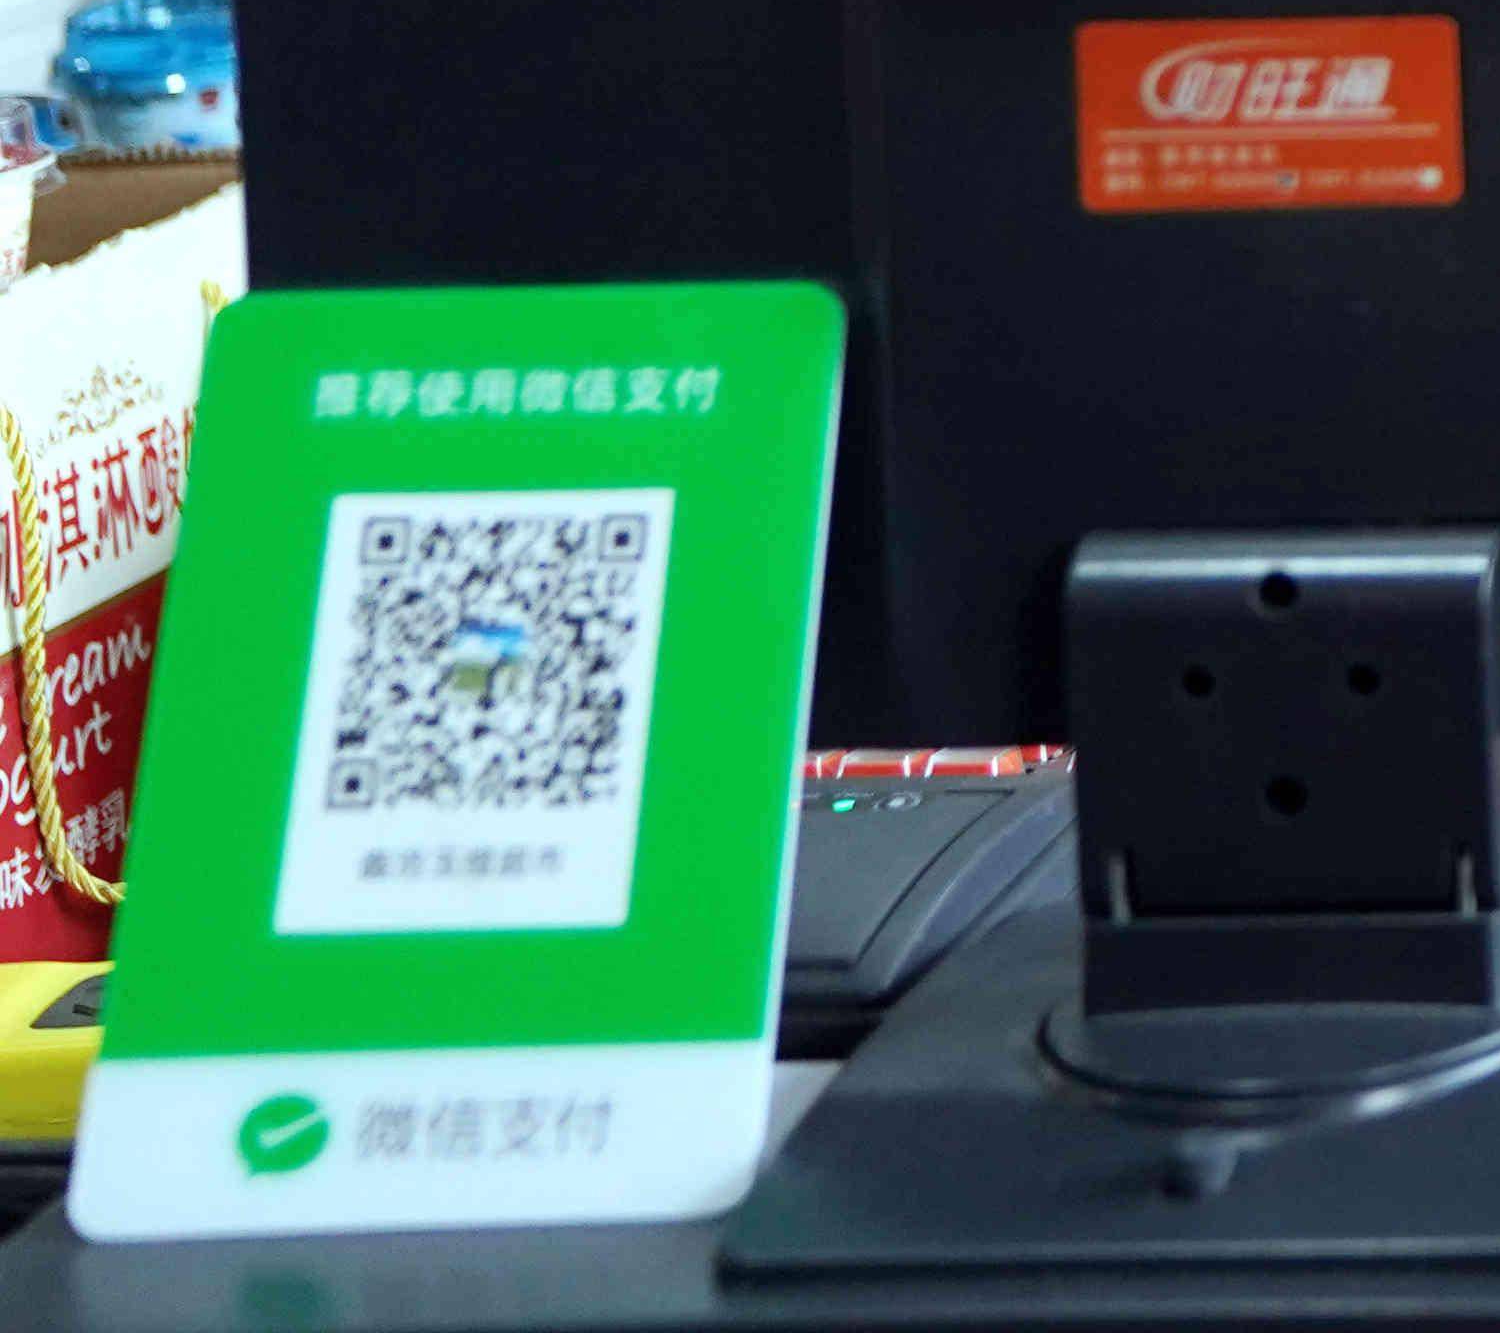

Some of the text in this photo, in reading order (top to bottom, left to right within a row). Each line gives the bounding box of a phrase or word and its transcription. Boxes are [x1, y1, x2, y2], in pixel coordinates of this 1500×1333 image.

[314, 365, 722, 419] 推荐使用微信支付
[43, 621, 150, 719] ream
[354, 1095, 613, 1161] 微信支付
